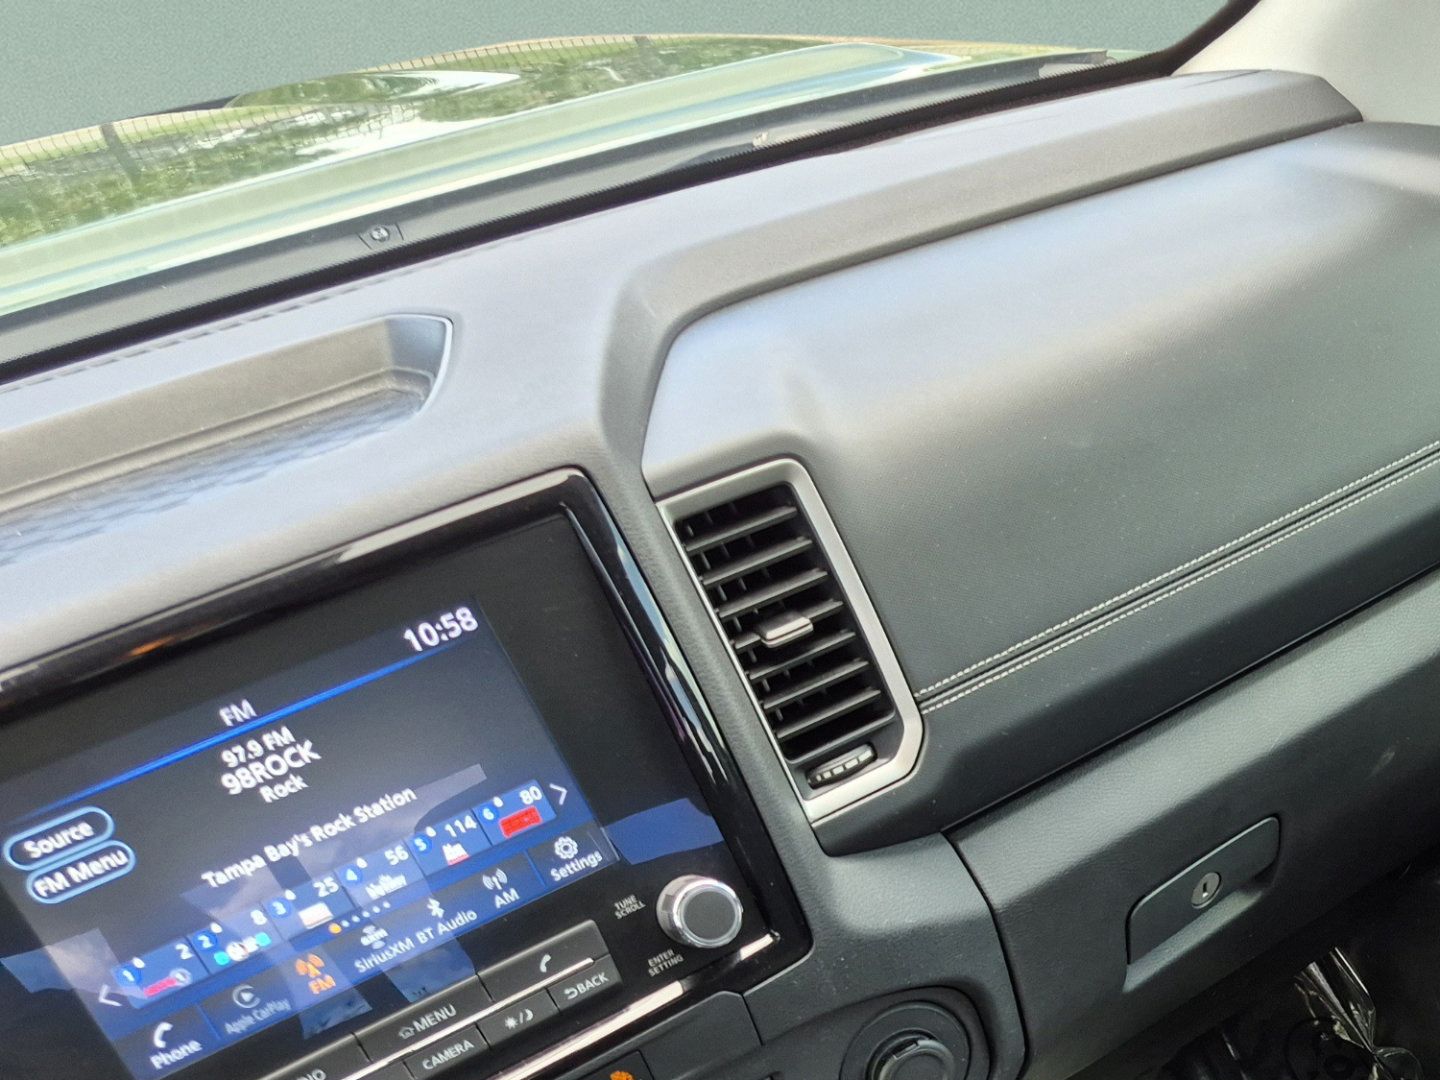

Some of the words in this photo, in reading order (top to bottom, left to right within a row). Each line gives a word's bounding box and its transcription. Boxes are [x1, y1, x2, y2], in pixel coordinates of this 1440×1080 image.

[403, 606, 478, 652] 10:58
[219, 699, 258, 727] FM
[221, 739, 264, 768] 97.9
[262, 726, 296, 751] FM
[220, 739, 322, 795] 98ROCK
[259, 773, 309, 803] Rock
[519, 785, 543, 805] 80
[23, 822, 95, 858] Source
[201, 854, 267, 888] Tampa
[264, 834, 313, 863] Bay's
[309, 813, 357, 841] Rock
[353, 788, 417, 823] Station
[444, 815, 477, 838] 114
[384, 845, 409, 866] 56
[550, 850, 603, 881] Settings
[34, 875, 71, 898] FM
[66, 850, 129, 884] Menu
[313, 876, 339, 898] 25
[494, 888, 520, 909] AM
[614, 894, 637, 910] TUNE
[614, 901, 646, 920] SCROLL
[416, 927, 434, 945] BT
[438, 909, 478, 936] Audio
[354, 937, 414, 973] SiriusXM
[648, 949, 674, 967] ENTER
[648, 955, 684, 977] SETTING
[576, 972, 609, 996] BACK
[412, 1004, 457, 1033] MENU
[150, 1039, 203, 1070] Phone
[422, 1039, 474, 1071] CAMERA
